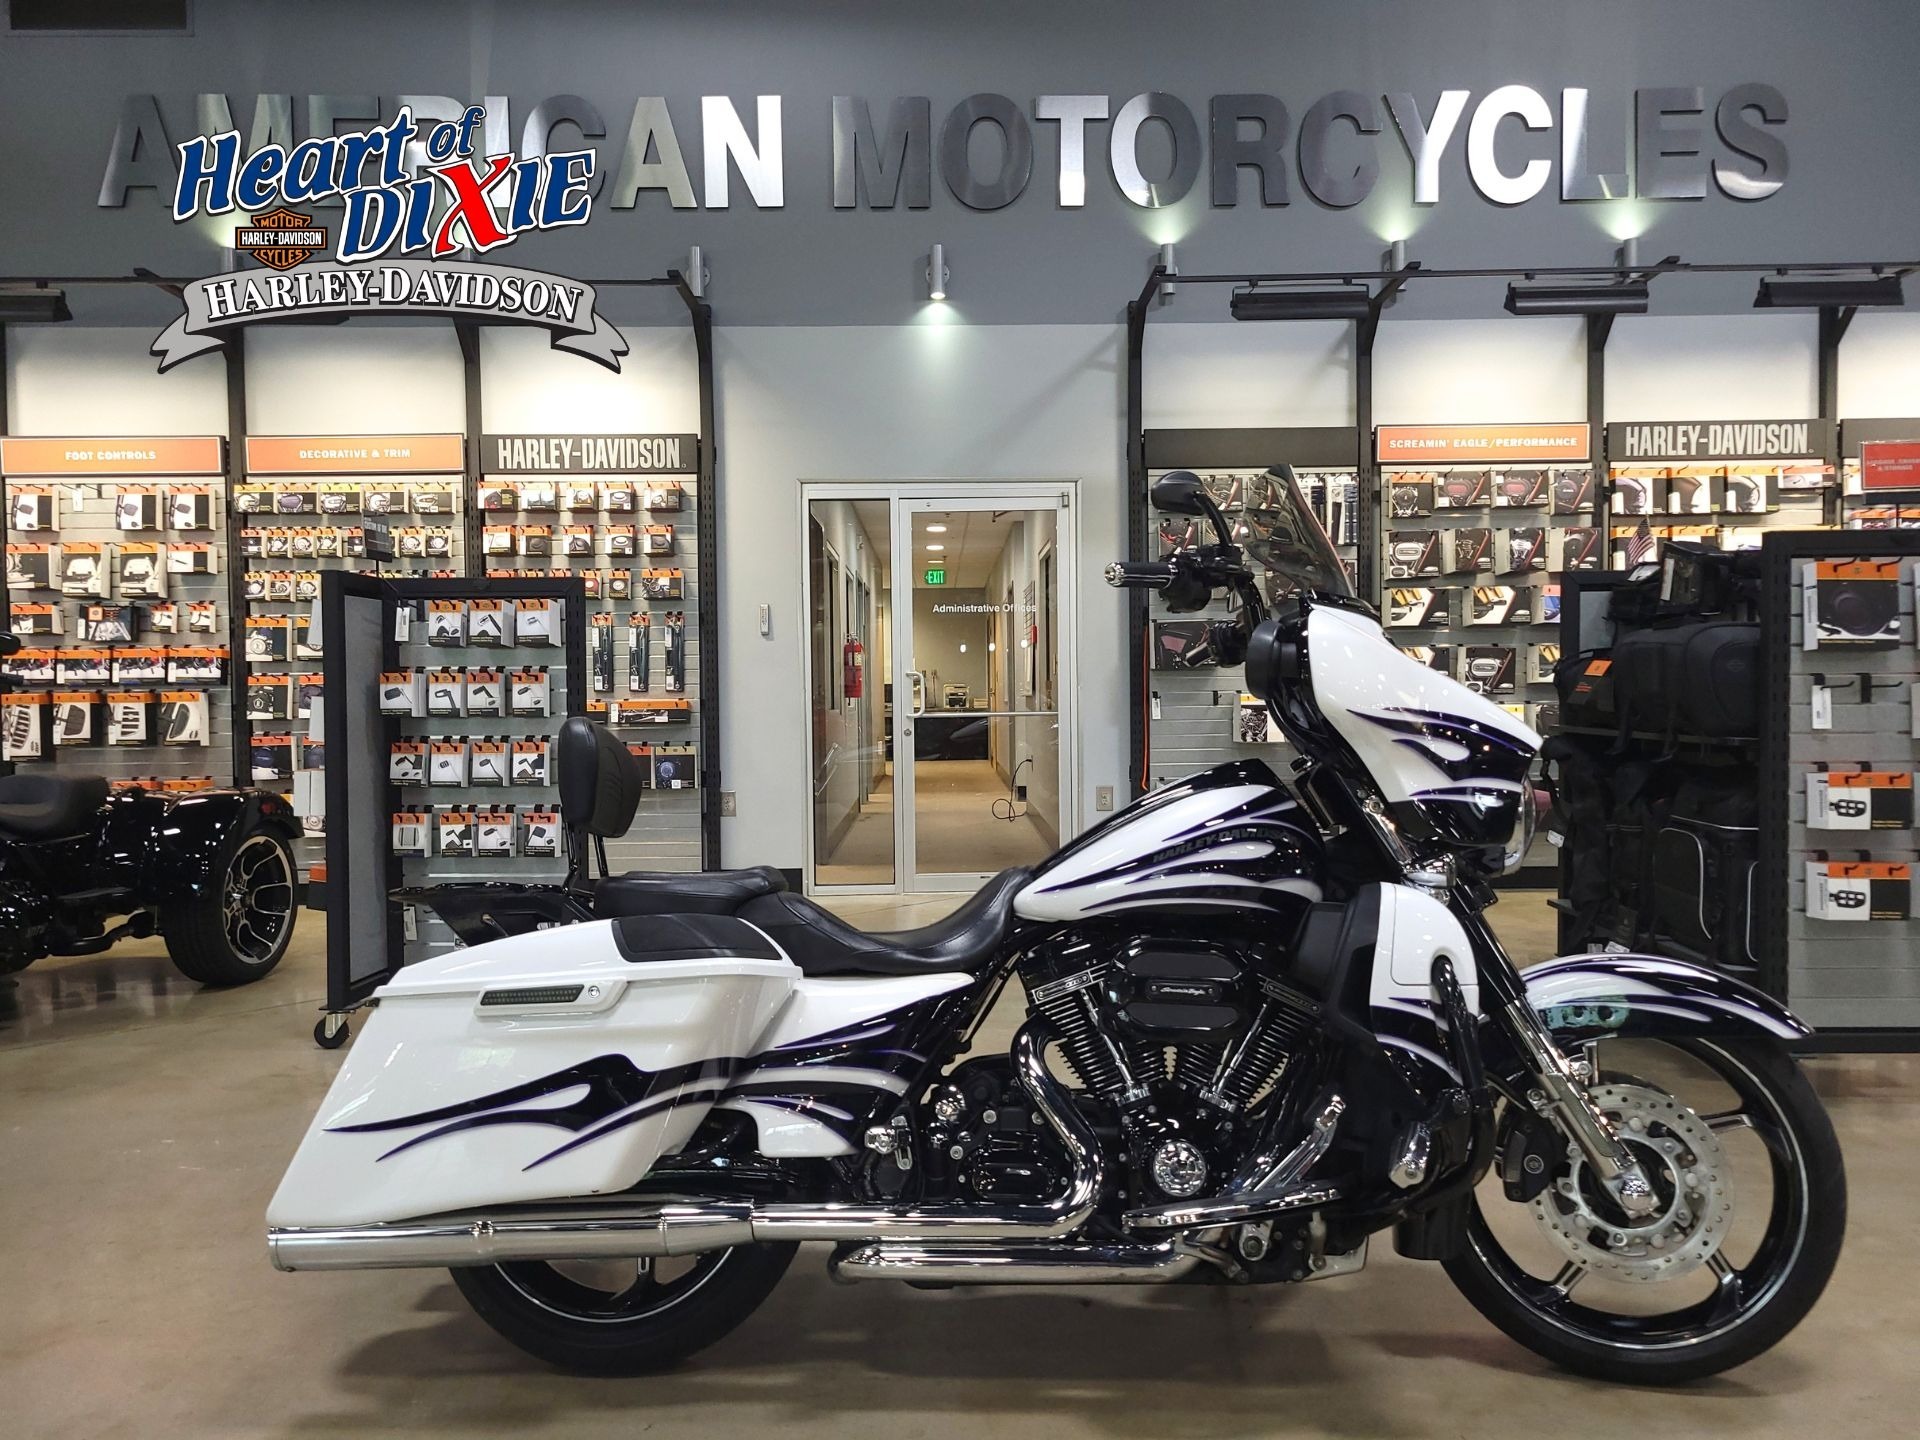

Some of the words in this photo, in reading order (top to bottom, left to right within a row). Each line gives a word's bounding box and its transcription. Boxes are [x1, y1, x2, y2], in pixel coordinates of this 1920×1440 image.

[831, 84, 1792, 210] MOTORCYCLES
[1389, 439, 1449, 449] SCREAMIN'
[1625, 423, 1808, 457] HARLEY-DAVIDSON
[65, 451, 93, 460] FOOT
[97, 450, 156, 460] CONTROLS
[299, 449, 368, 459] DECORATIVE
[371, 449, 380, 458] &
[383, 448, 411, 458] TRIM
[498, 438, 680, 470] HARLEY-DAVIDSON
[927, 571, 945, 584] EXIT
[932, 604, 1000, 613] Administrative
[1002, 603, 1037, 613] Offices
